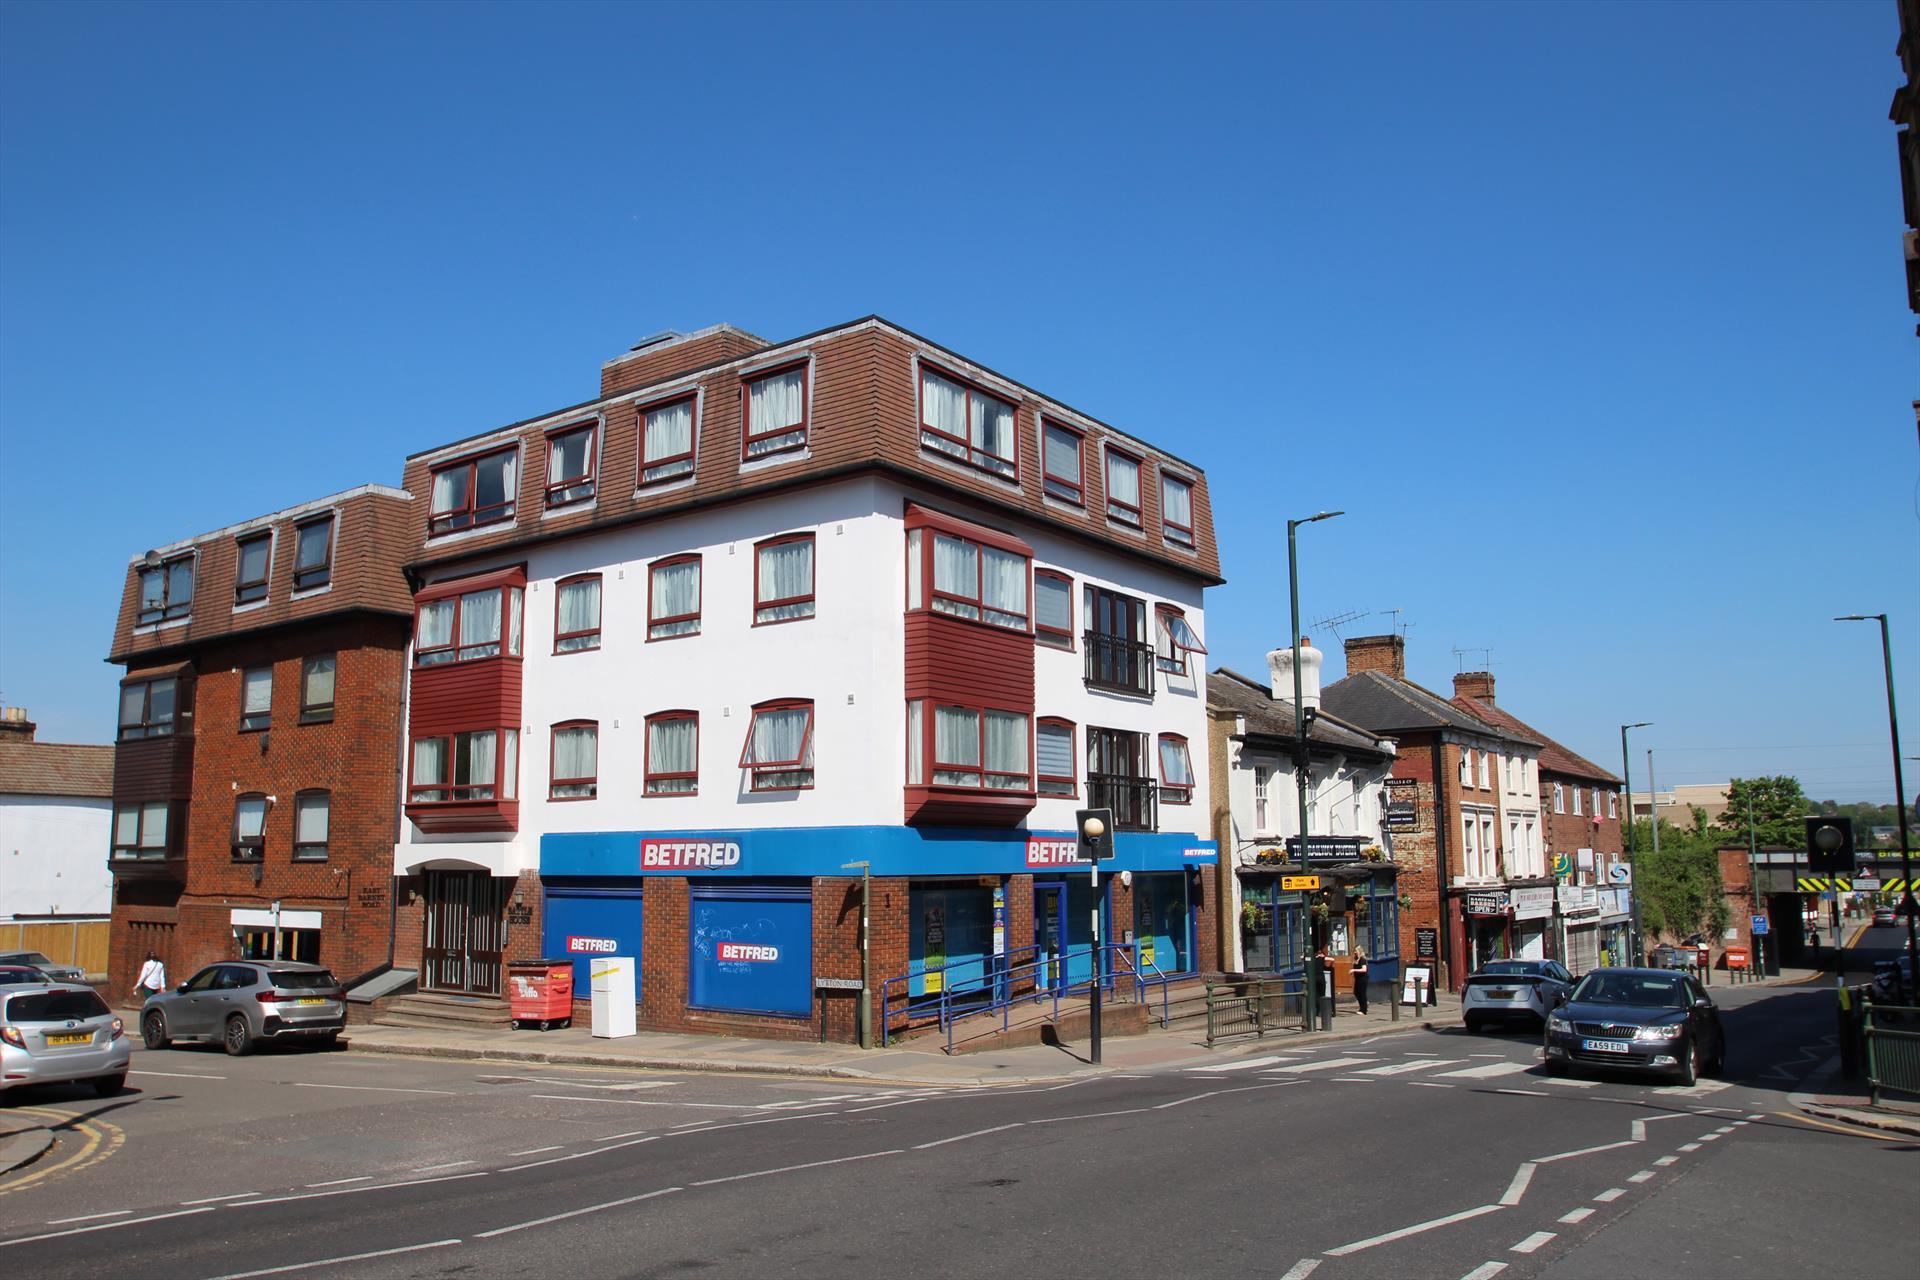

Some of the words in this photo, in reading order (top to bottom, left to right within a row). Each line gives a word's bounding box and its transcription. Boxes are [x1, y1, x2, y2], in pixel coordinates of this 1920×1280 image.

[644, 843, 740, 866] BETFRED
[1028, 842, 1092, 863] BETFR
[1307, 844, 1334, 857] RAILWAY
[1335, 844, 1357, 857] TAVERN
[571, 938, 617, 952] BETFRED
[723, 945, 779, 960] BETFRED
[843, 980, 863, 988] ROAD
[1588, 1041, 1609, 1050] EA59
[1610, 1043, 1627, 1051] EDL
